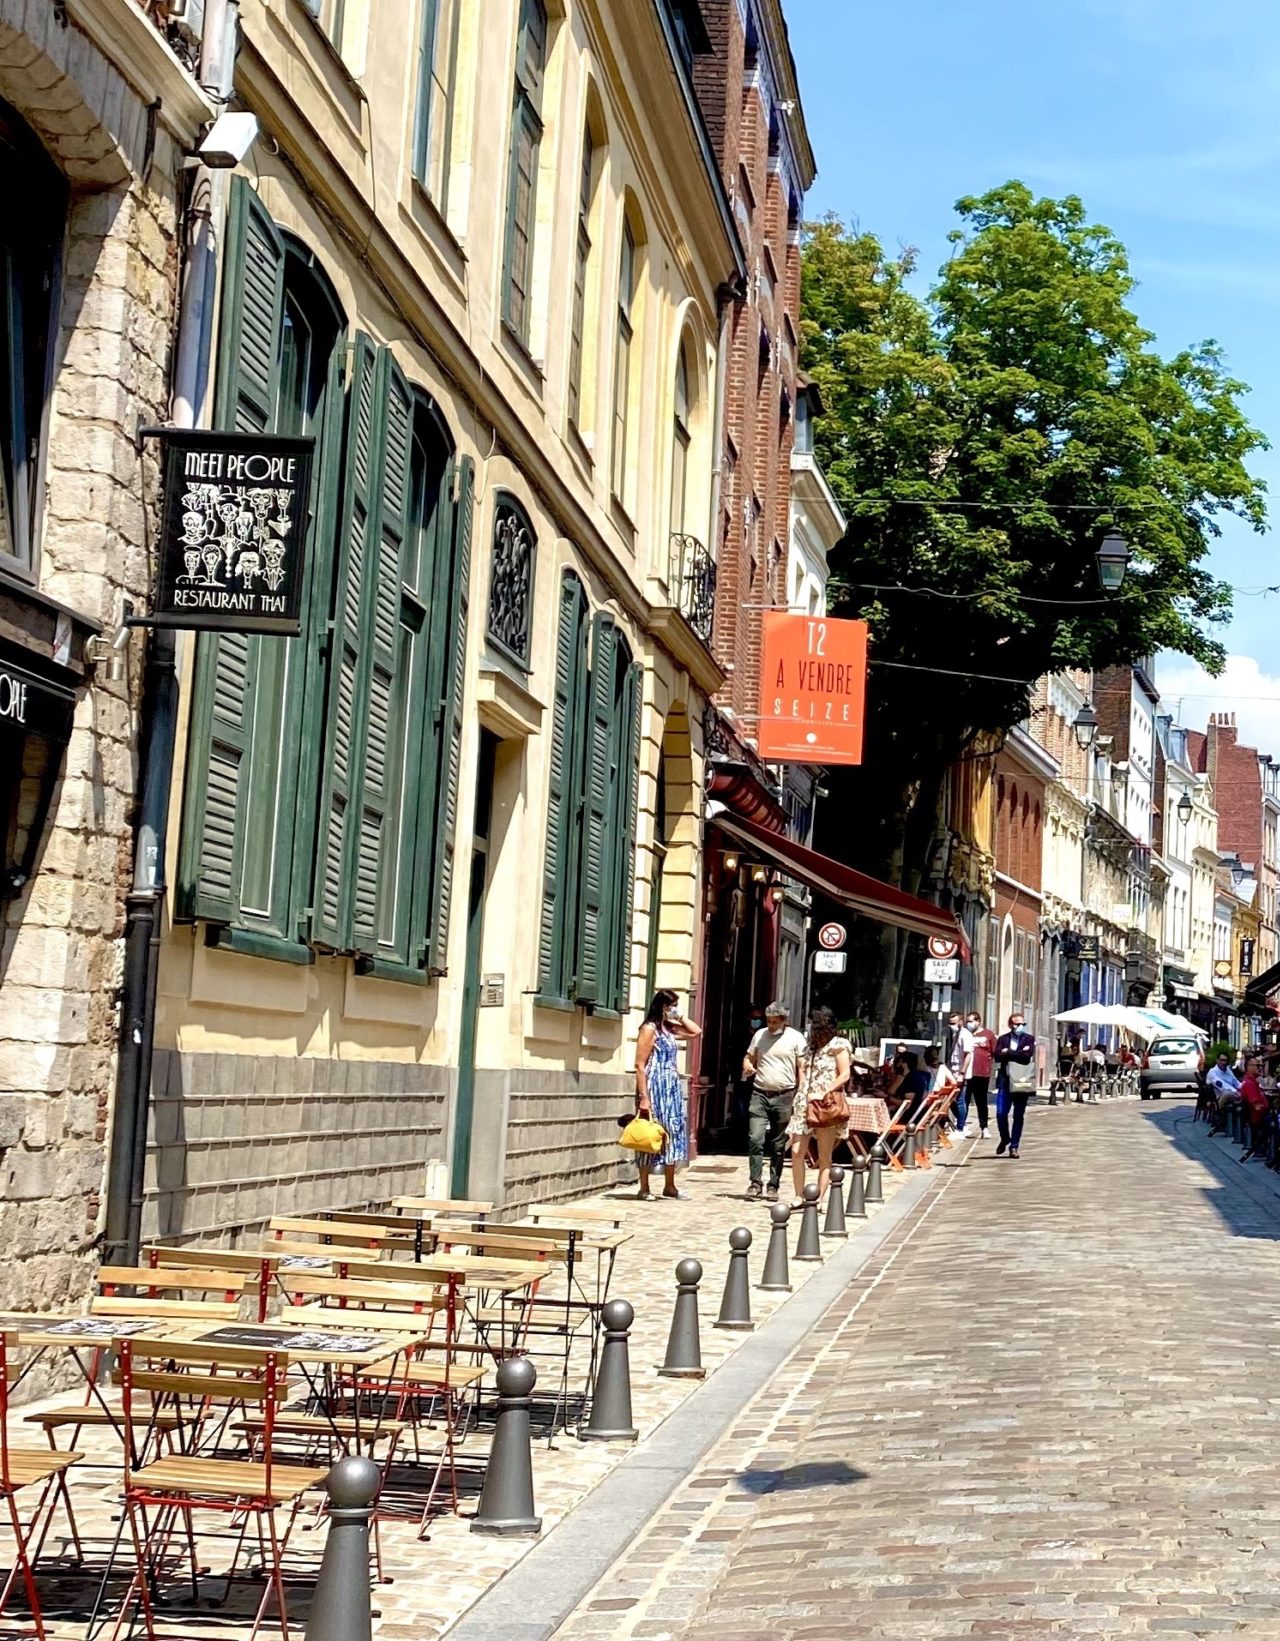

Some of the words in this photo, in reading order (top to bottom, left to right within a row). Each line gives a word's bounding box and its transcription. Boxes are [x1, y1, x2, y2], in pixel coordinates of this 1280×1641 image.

[184, 452, 224, 478] MEET
[227, 454, 296, 483] PEOPLE
[174, 589, 255, 611] RESTAURANT
[260, 595, 286, 613] THAI
[807, 621, 827, 656] T2
[798, 659, 853, 695] VENDRE
[774, 697, 850, 721] SEIZE
